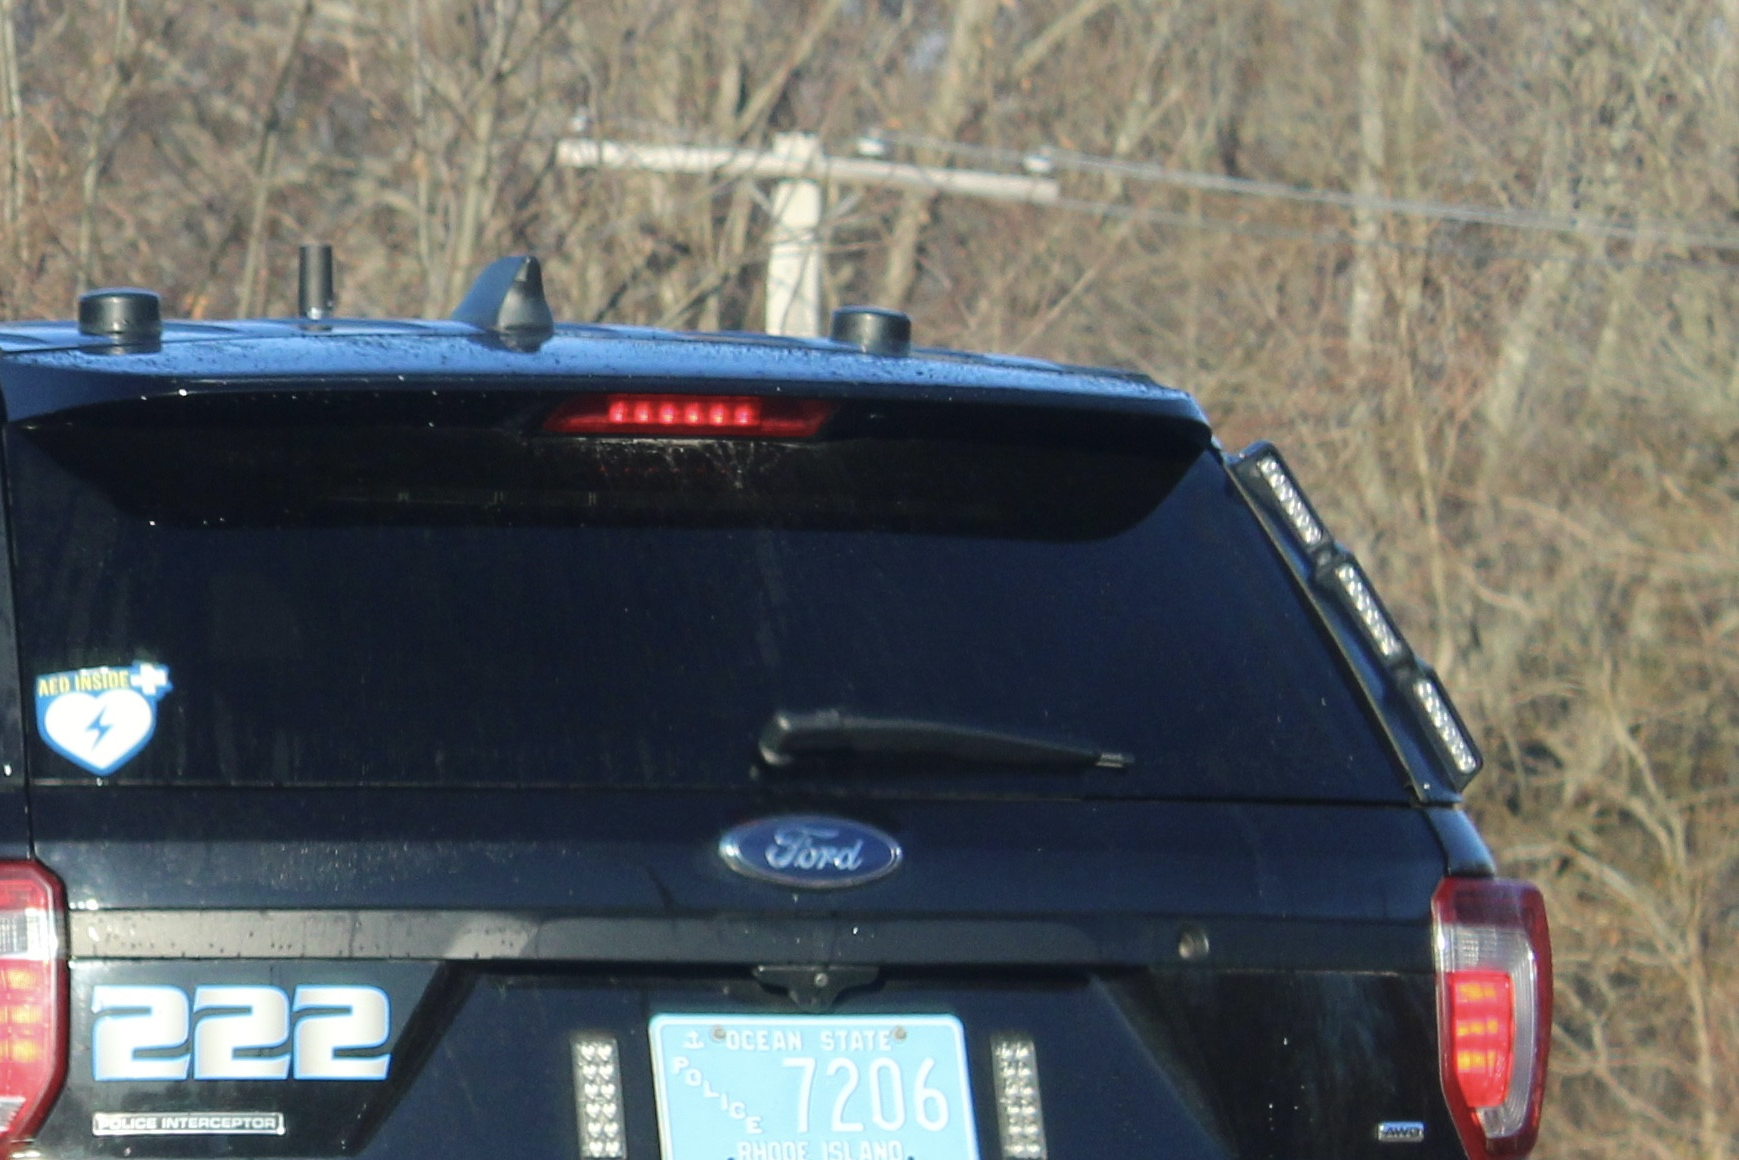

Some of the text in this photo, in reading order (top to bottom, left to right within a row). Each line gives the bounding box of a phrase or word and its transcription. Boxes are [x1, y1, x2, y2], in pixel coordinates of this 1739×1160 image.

[38, 669, 130, 697] AED INSIDE
[765, 827, 864, 871] Ford
[91, 984, 392, 1081] 222
[725, 1029, 892, 1051] OCEAN STATE
[670, 1056, 764, 1134] POLICE
[782, 1056, 949, 1133] 7206
[98, 1116, 276, 1130] POLICE INTERCEPTOR
